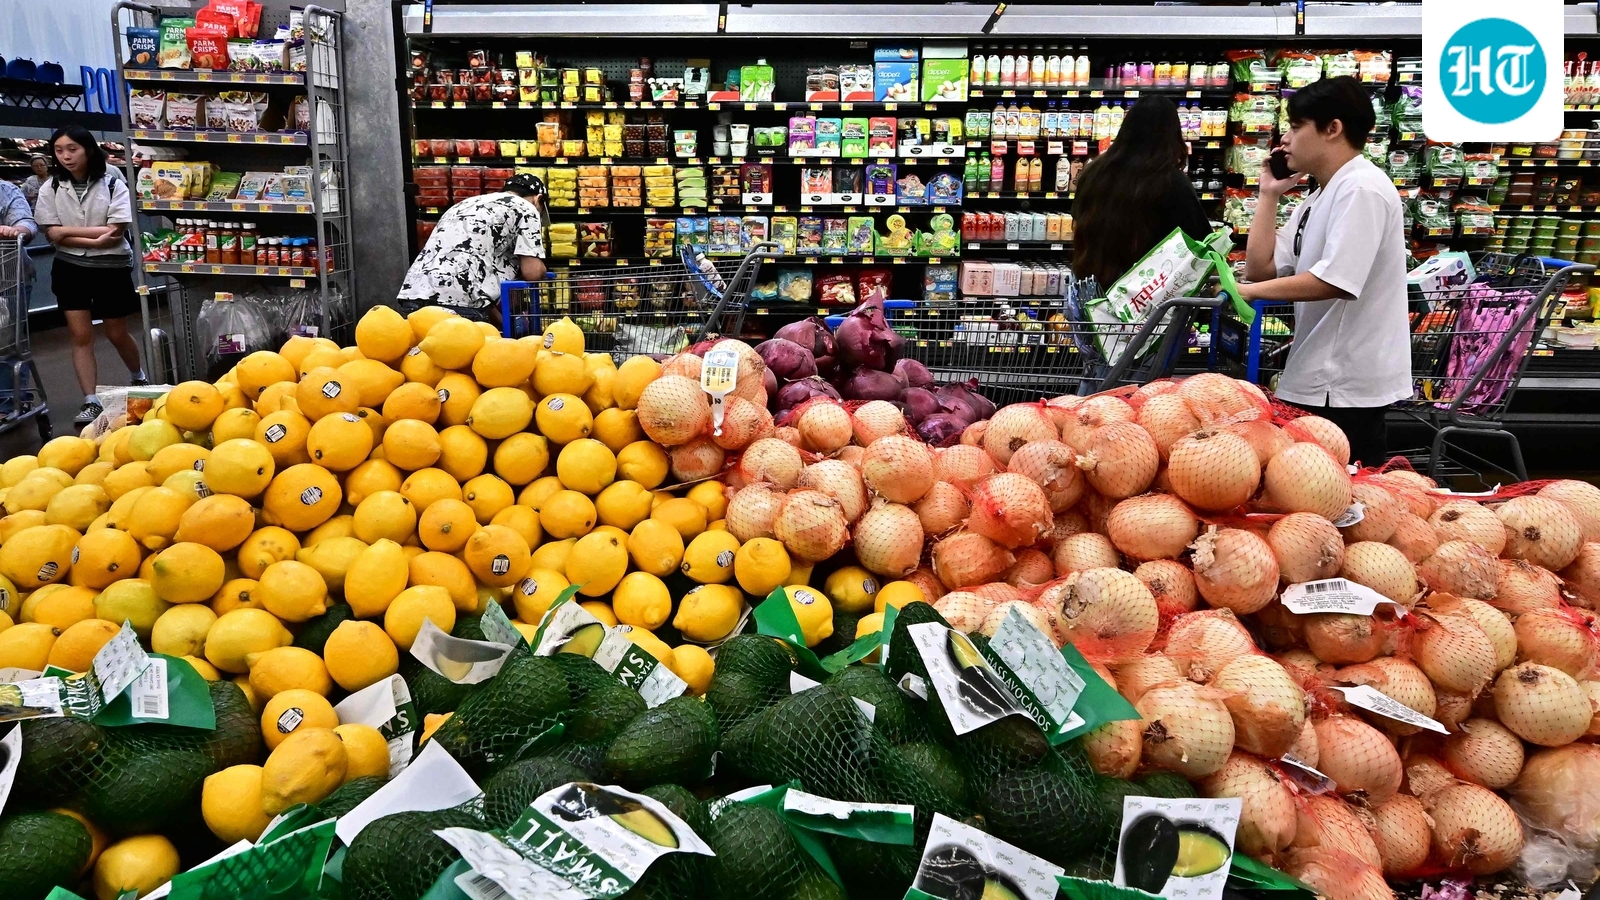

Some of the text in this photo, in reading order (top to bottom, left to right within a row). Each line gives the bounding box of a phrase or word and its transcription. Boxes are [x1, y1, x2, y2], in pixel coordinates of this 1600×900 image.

[204, 22, 226, 30] PARM
[132, 43, 156, 51] CRISPS
[927, 624, 938, 637] Small
[1002, 622, 1014, 636] Small
[920, 634, 932, 648] Small
[986, 654, 1051, 732] HASS AVOCADOS
[1056, 680, 1068, 696] Small
[1056, 698, 1068, 713] Small
[957, 712, 970, 730] Small
[1185, 803, 1201, 811] Small
[1214, 803, 1229, 811] Small
[570, 826, 588, 840] Small
[935, 825, 952, 837] Small
[620, 842, 637, 857] Small
[965, 838, 982, 850] Small
[518, 818, 620, 894] SMALL
[996, 852, 1014, 865] Small
[1027, 866, 1046, 880] Small
[1034, 886, 1053, 899] Small
